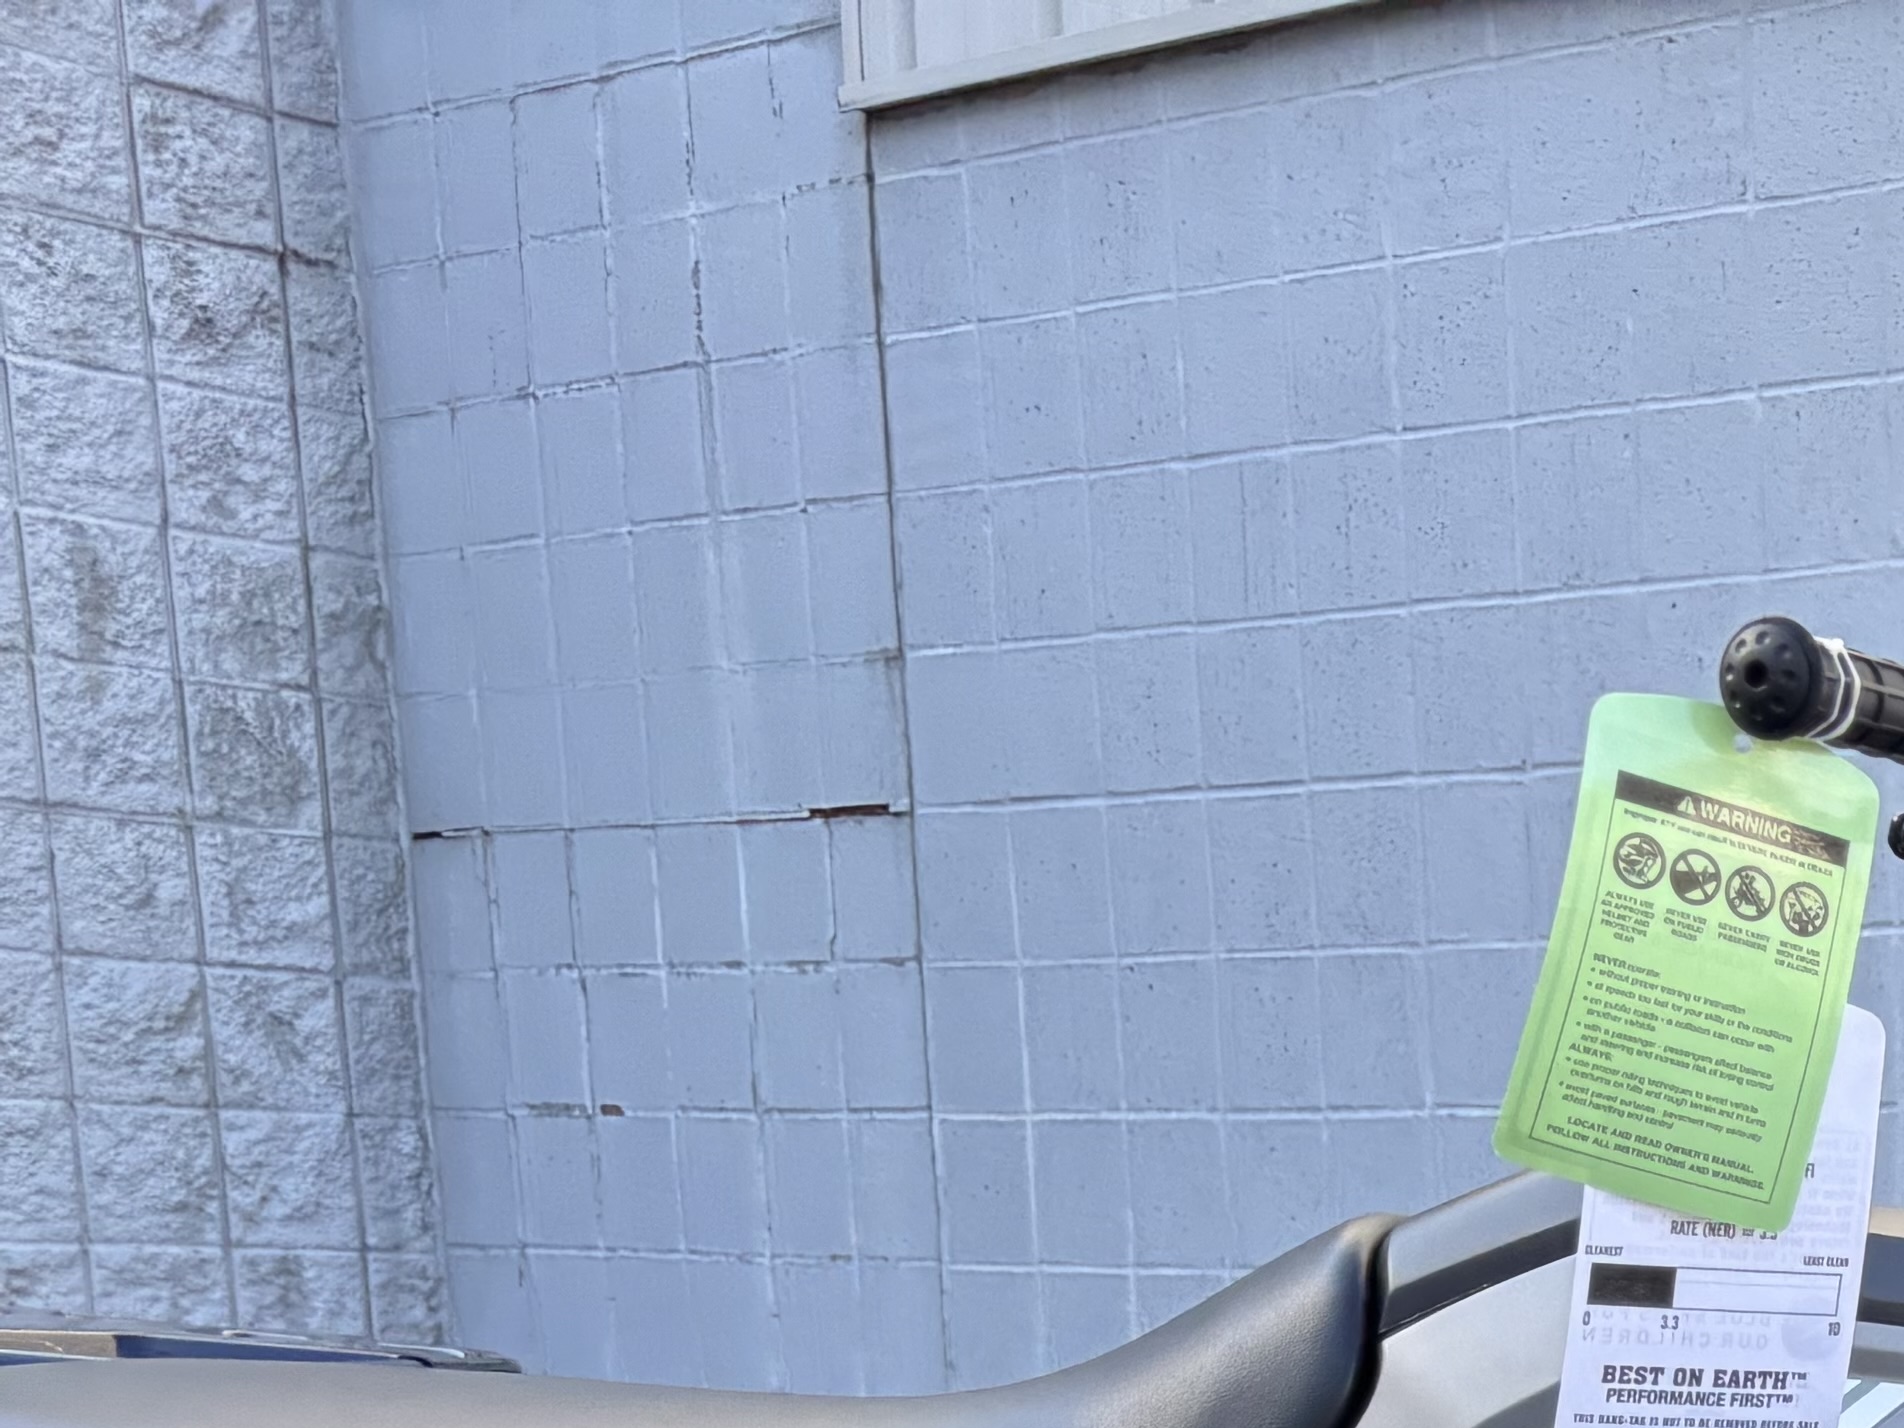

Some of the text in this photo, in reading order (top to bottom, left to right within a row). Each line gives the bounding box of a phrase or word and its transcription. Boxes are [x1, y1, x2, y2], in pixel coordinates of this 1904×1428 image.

[1699, 800, 1792, 843] WARNING
[1567, 1116, 1607, 1134] LOCATE
[1610, 1128, 1632, 1140] AND
[1634, 1134, 1661, 1148] READ
[1546, 1125, 1589, 1142] FOLLOW
[1592, 1137, 1610, 1148] ALL
[1688, 1163, 1709, 1174] AND
[1670, 1220, 1698, 1237] RATE
[1582, 1311, 1591, 1325] 0
[1660, 1315, 1679, 1330] 3.3
[1602, 1365, 1665, 1384] BEST
[1673, 1367, 1704, 1386] ON
[1605, 1388, 1726, 1407] PERFORMANCE
[1574, 1413, 1594, 1423] THIS
